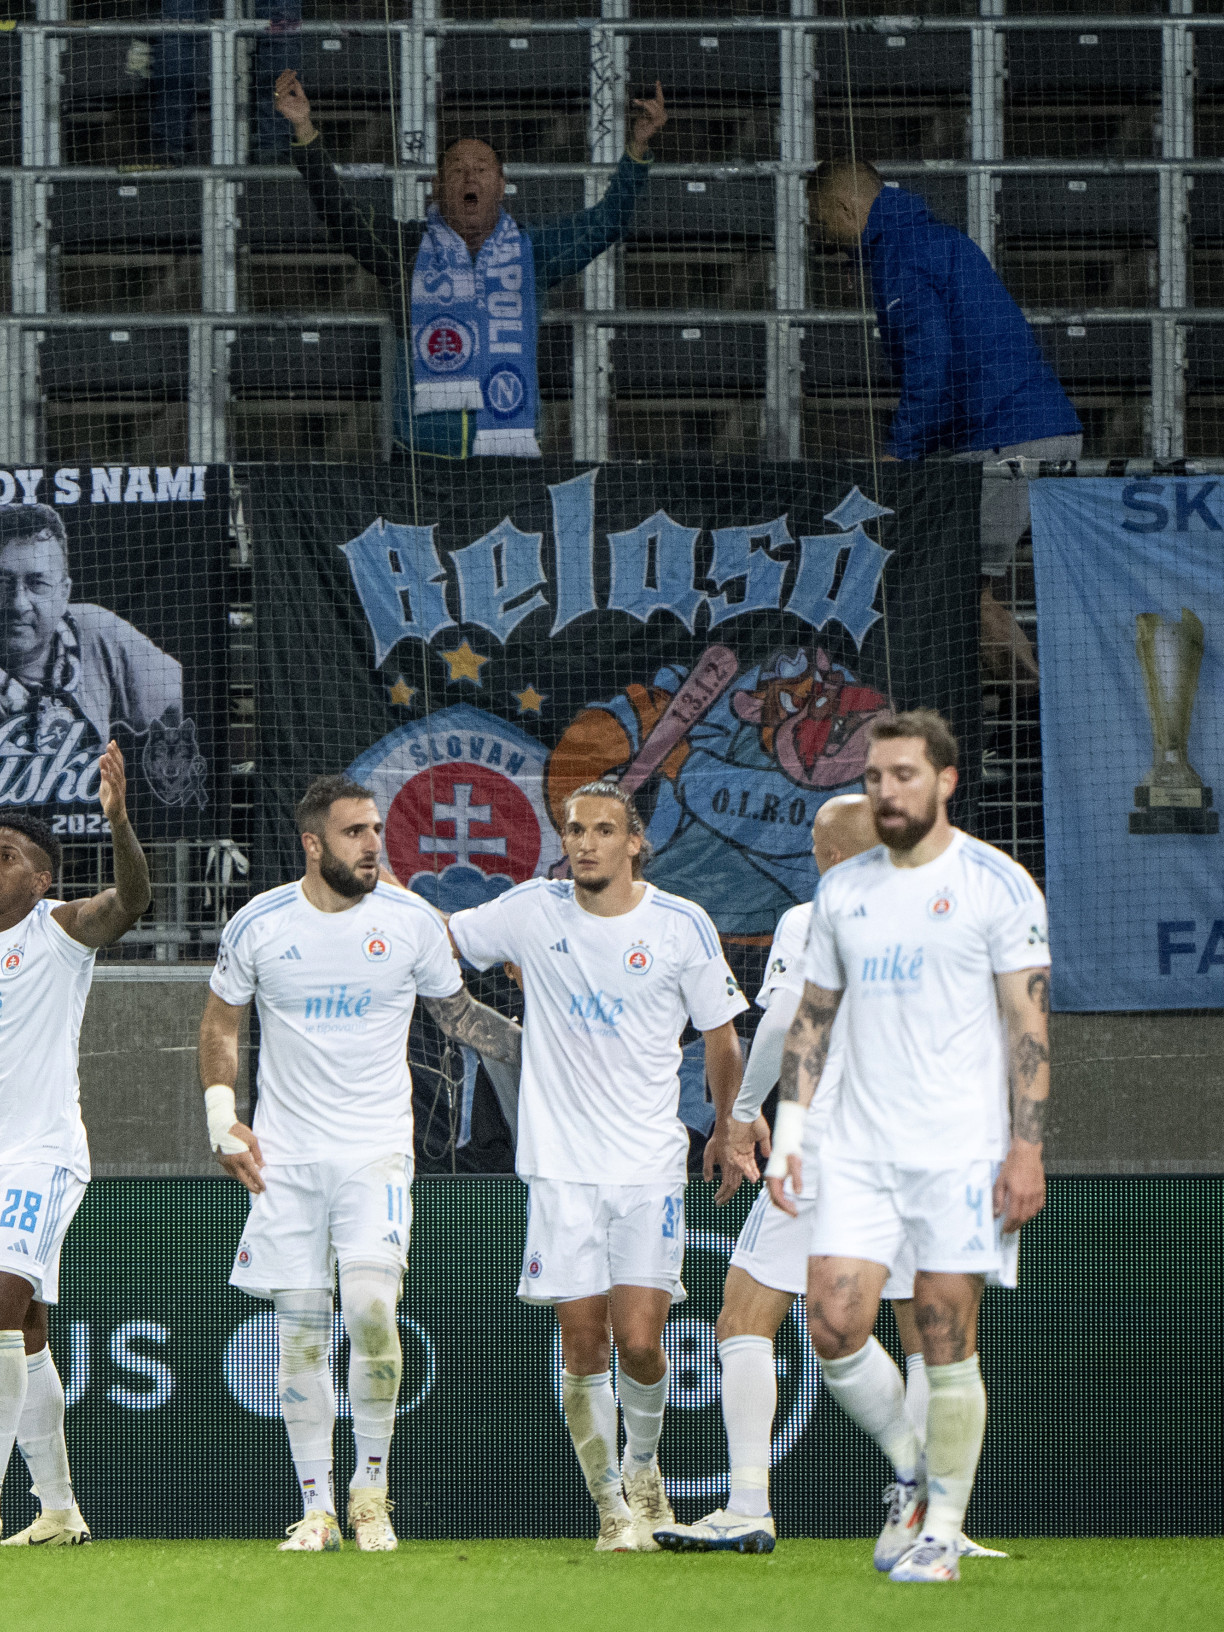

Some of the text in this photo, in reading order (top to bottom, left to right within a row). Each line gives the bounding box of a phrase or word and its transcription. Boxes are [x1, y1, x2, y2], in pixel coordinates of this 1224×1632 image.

[54, 467, 82, 505] S
[90, 464, 208, 504] NAMI
[408, 734, 527, 777] SLOVAN
[0, 1188, 44, 1234] 28
[384, 1183, 403, 1225] 11
[965, 1183, 983, 1228] 4
